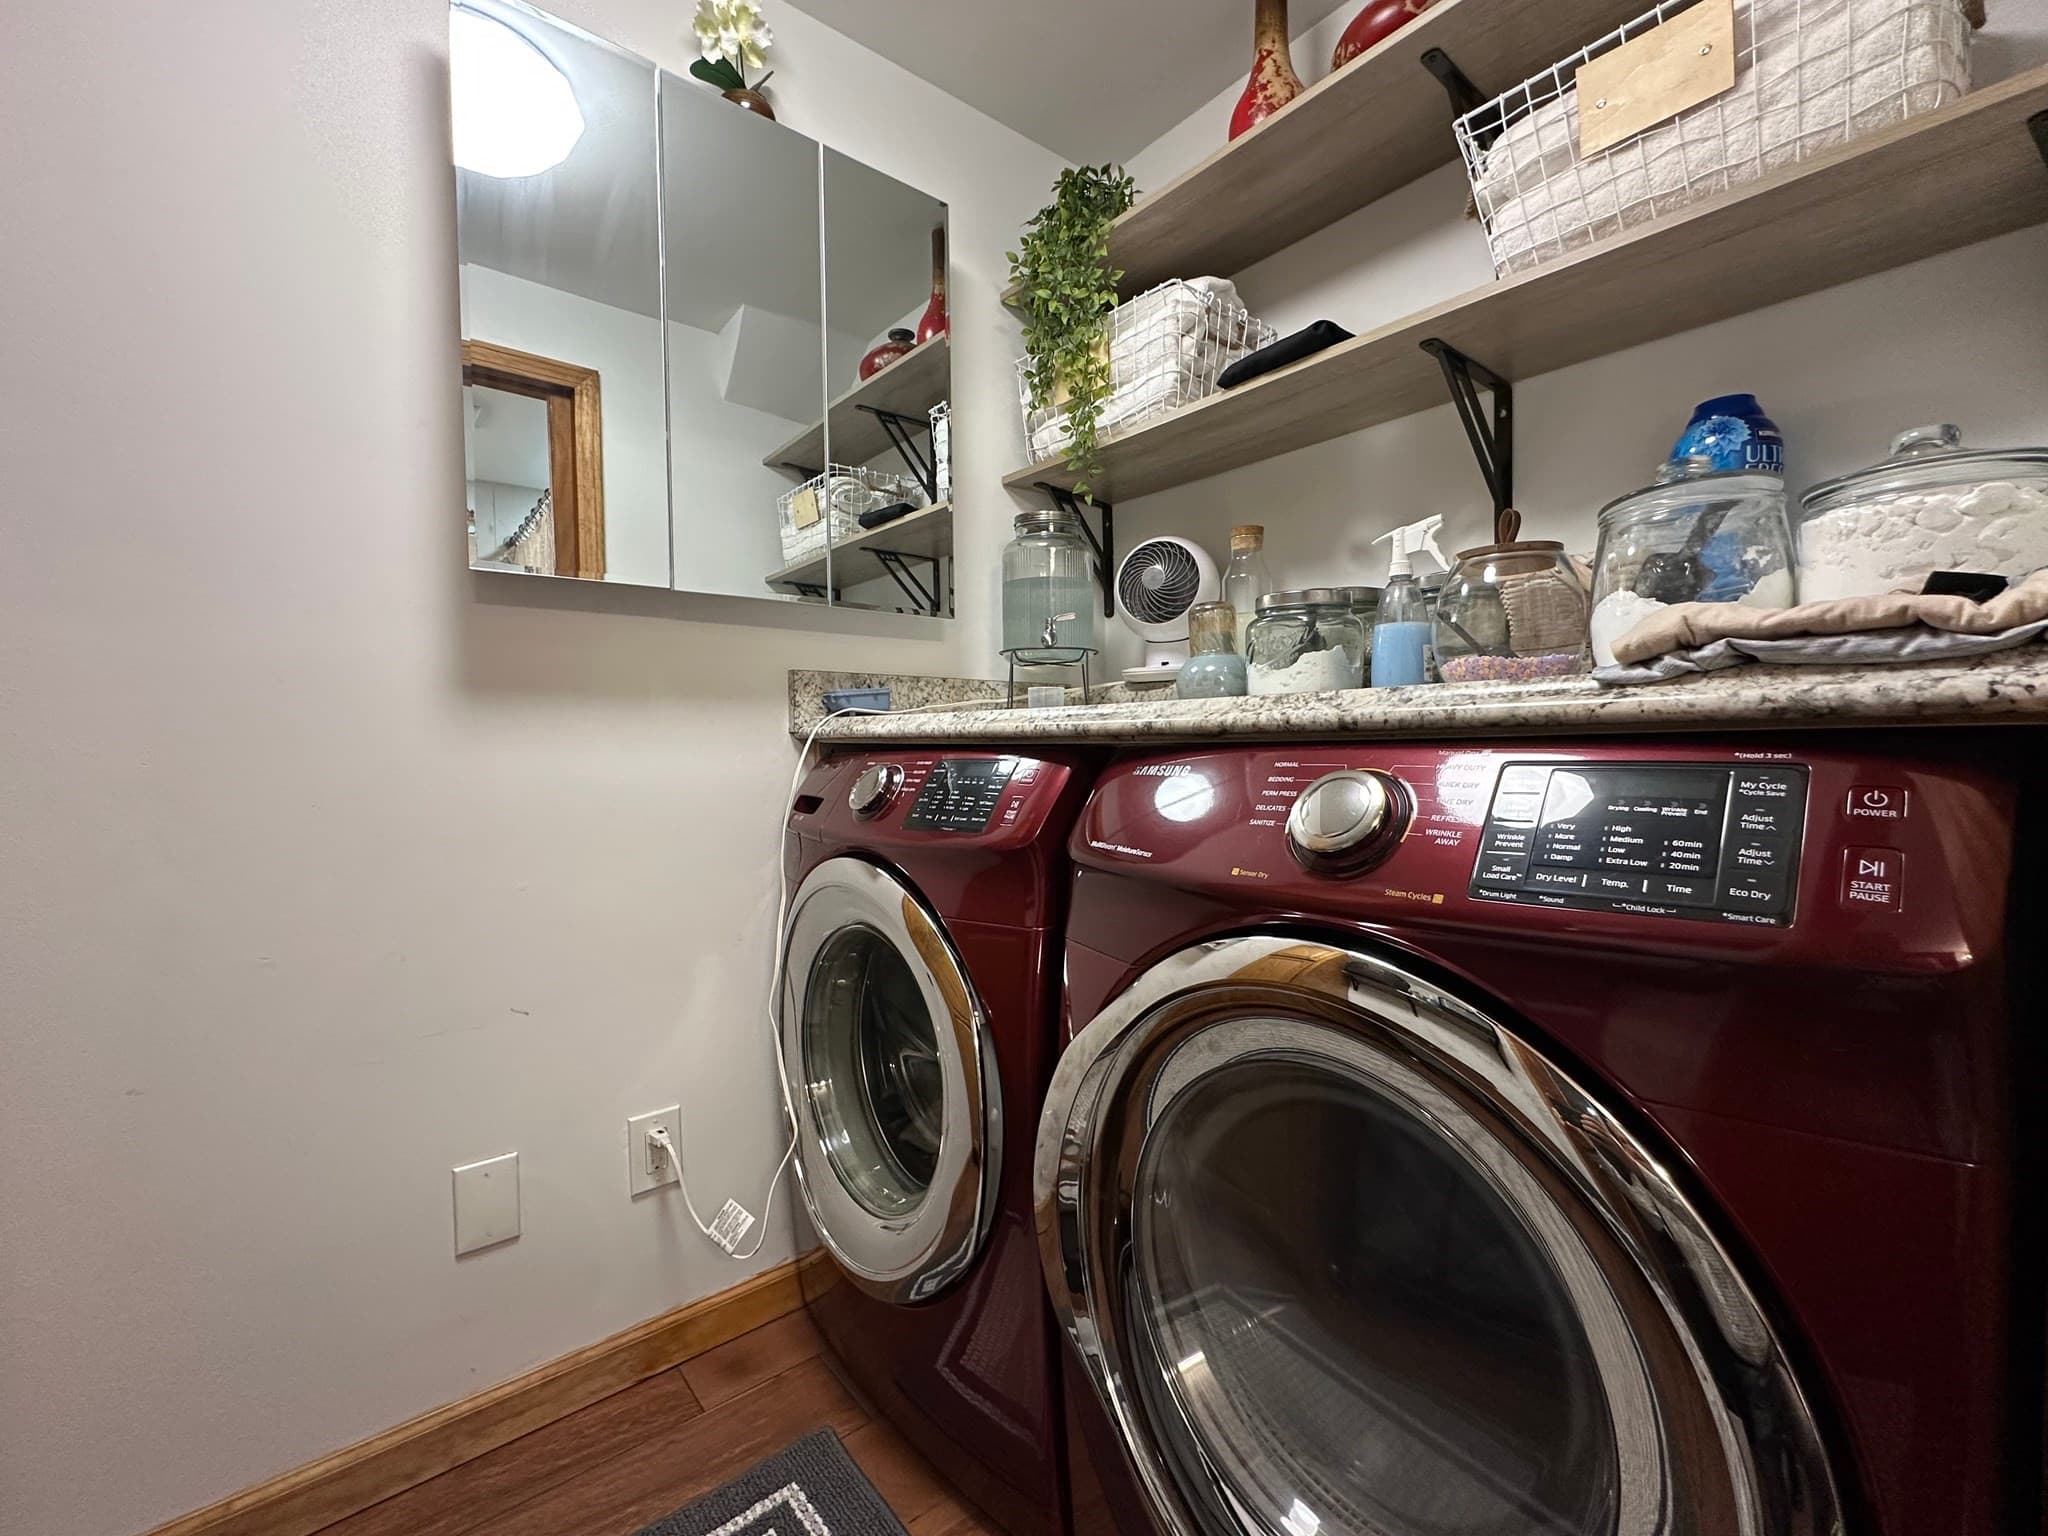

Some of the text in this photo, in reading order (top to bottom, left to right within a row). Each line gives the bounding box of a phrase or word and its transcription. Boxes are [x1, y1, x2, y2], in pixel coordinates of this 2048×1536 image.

[1133, 765, 1192, 777] SAMSUNG
[1740, 781, 1788, 791] My Cycle
[1766, 790, 1787, 798] Save
[1255, 804, 1287, 812] DELICATES
[1853, 808, 1897, 818] POWER
[1249, 818, 1276, 827] SANITIZE
[1741, 814, 1775, 824] Adjust
[1557, 822, 1576, 831] Very
[1612, 824, 1632, 833] High
[1740, 822, 1765, 831] Time
[1425, 828, 1463, 839] WRINKLE
[1497, 833, 1526, 842] Wrinkle
[1554, 832, 1576, 841] More
[1434, 838, 1461, 847] AWAY
[1494, 840, 1524, 849] Prevent
[1609, 835, 1644, 845] Medium
[1672, 840, 1703, 849] 60min
[1552, 842, 1581, 852] Normal
[1607, 846, 1627, 854] Low
[1550, 854, 1574, 863] Damp
[1670, 851, 1701, 860] 40min
[1738, 848, 1772, 859] Adjust
[1605, 857, 1649, 867] Extra Low
[1737, 857, 1763, 866] Time
[1491, 865, 1512, 874] Small
[1668, 862, 1700, 872] 20min
[1482, 872, 1500, 881] Load
[1535, 873, 1578, 884] Dry Level
[1601, 878, 1630, 889] Temp.
[1851, 880, 1892, 893] START
[1384, 888, 1433, 901] Steam Cycles
[1666, 884, 1694, 895] Time
[1729, 887, 1772, 901] Eco Dry
[1500, 892, 1518, 900] Light
[1849, 890, 1891, 904] PAUSE
[1646, 904, 1667, 914] Lock
[1755, 914, 1777, 925] Care
